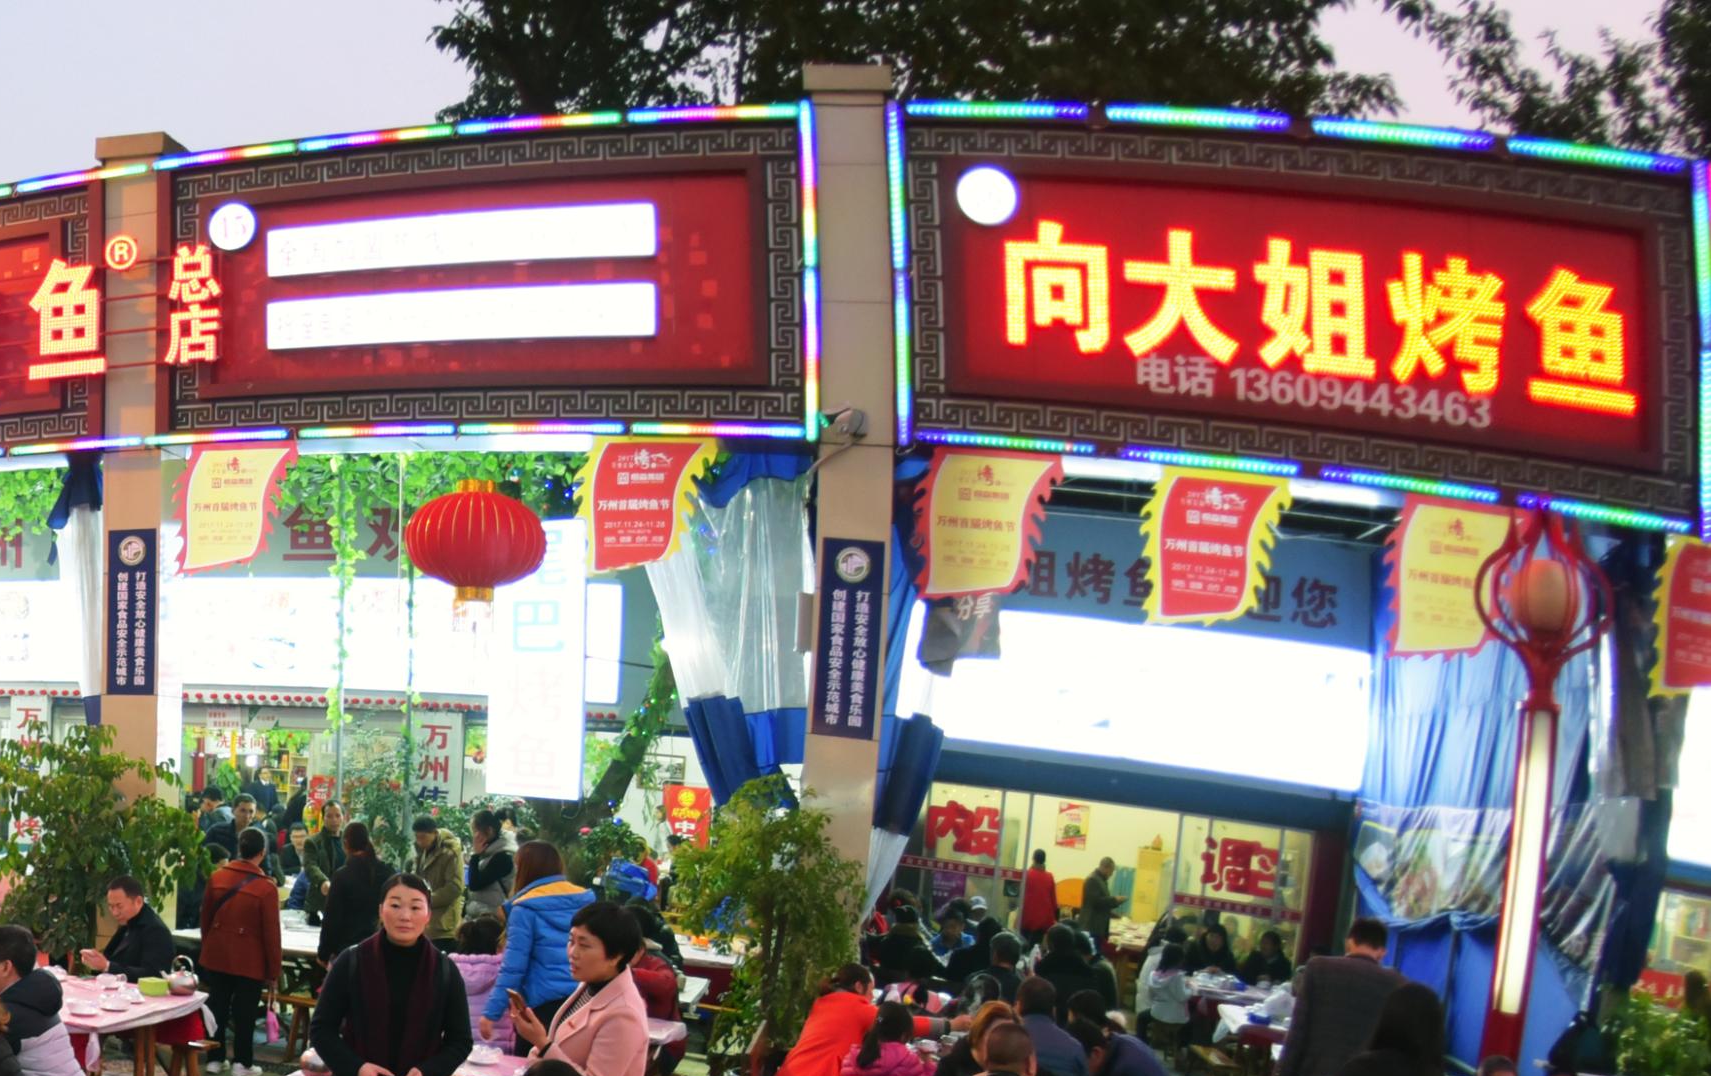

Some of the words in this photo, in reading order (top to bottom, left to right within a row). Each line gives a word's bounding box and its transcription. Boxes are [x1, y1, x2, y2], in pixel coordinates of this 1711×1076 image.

[164, 243, 221, 365] 总店
[1003, 218, 1638, 418] 向大姐烤鱼
[1135, 353, 1217, 398] 电话
[1231, 366, 1492, 431] 13609443463
[597, 498, 670, 512] 万州首届烤鱼节
[937, 515, 1016, 532] 万州首届烤鱼节
[1163, 537, 1244, 558] 万州首届烤鱼节
